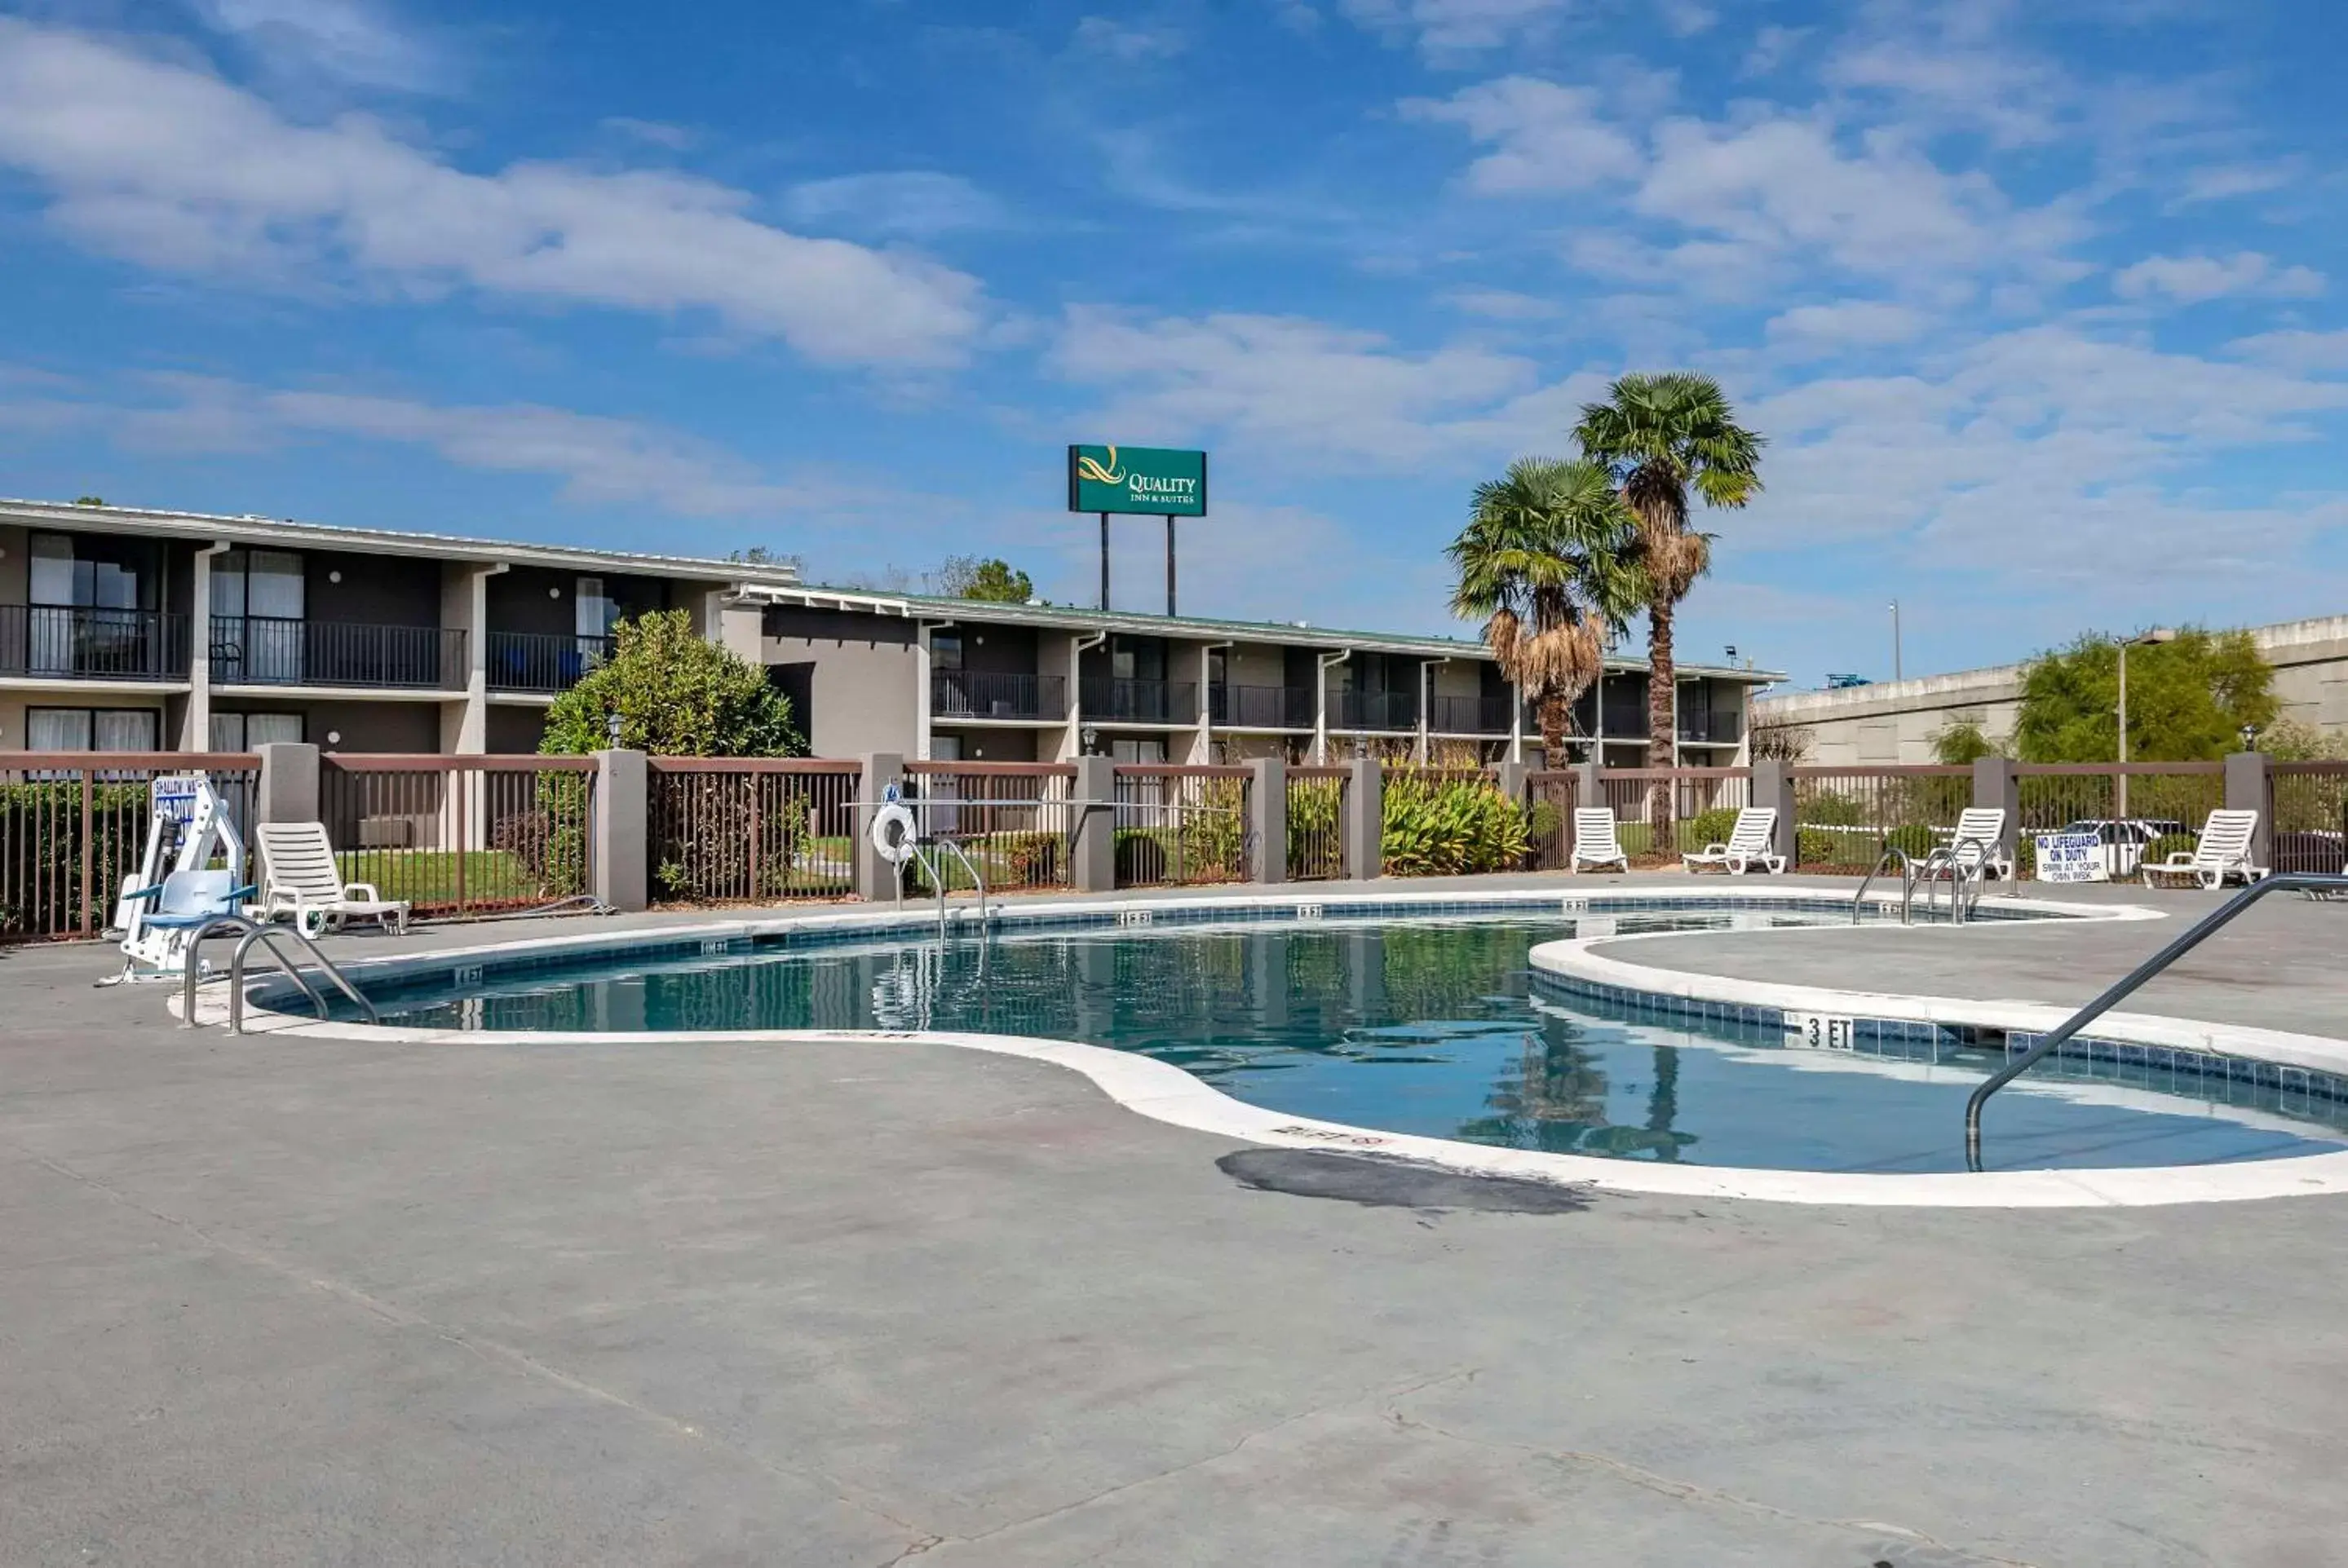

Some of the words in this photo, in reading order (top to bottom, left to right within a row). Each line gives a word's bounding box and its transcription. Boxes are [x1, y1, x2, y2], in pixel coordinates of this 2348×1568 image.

[1130, 474, 1196, 492] QUALITY
[1161, 496, 1194, 504] SUITES
[2037, 837, 2048, 848] NO
[2052, 836, 2098, 848] LIFEGUARD
[2050, 850, 2061, 861] ON
[2065, 849, 2087, 861] DUTY
[2079, 862, 2101, 871] YOUR
